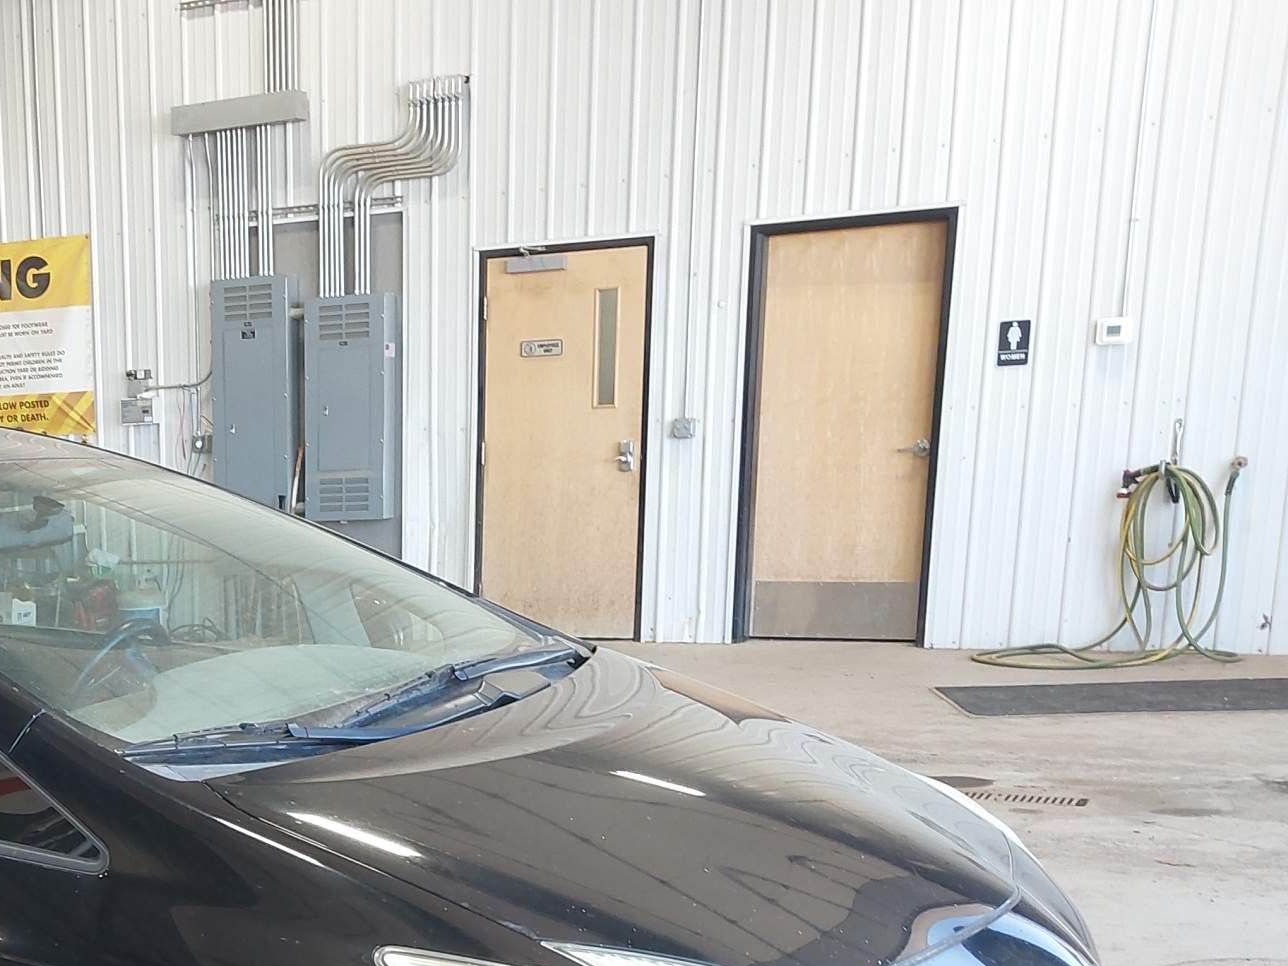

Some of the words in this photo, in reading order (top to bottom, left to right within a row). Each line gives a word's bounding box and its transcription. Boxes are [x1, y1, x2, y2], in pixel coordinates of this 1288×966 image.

[1000, 352, 1026, 361] WOMEN
[20, 399, 50, 410] POSTED
[7, 414, 19, 423] OR
[21, 412, 49, 423] DEATH.
